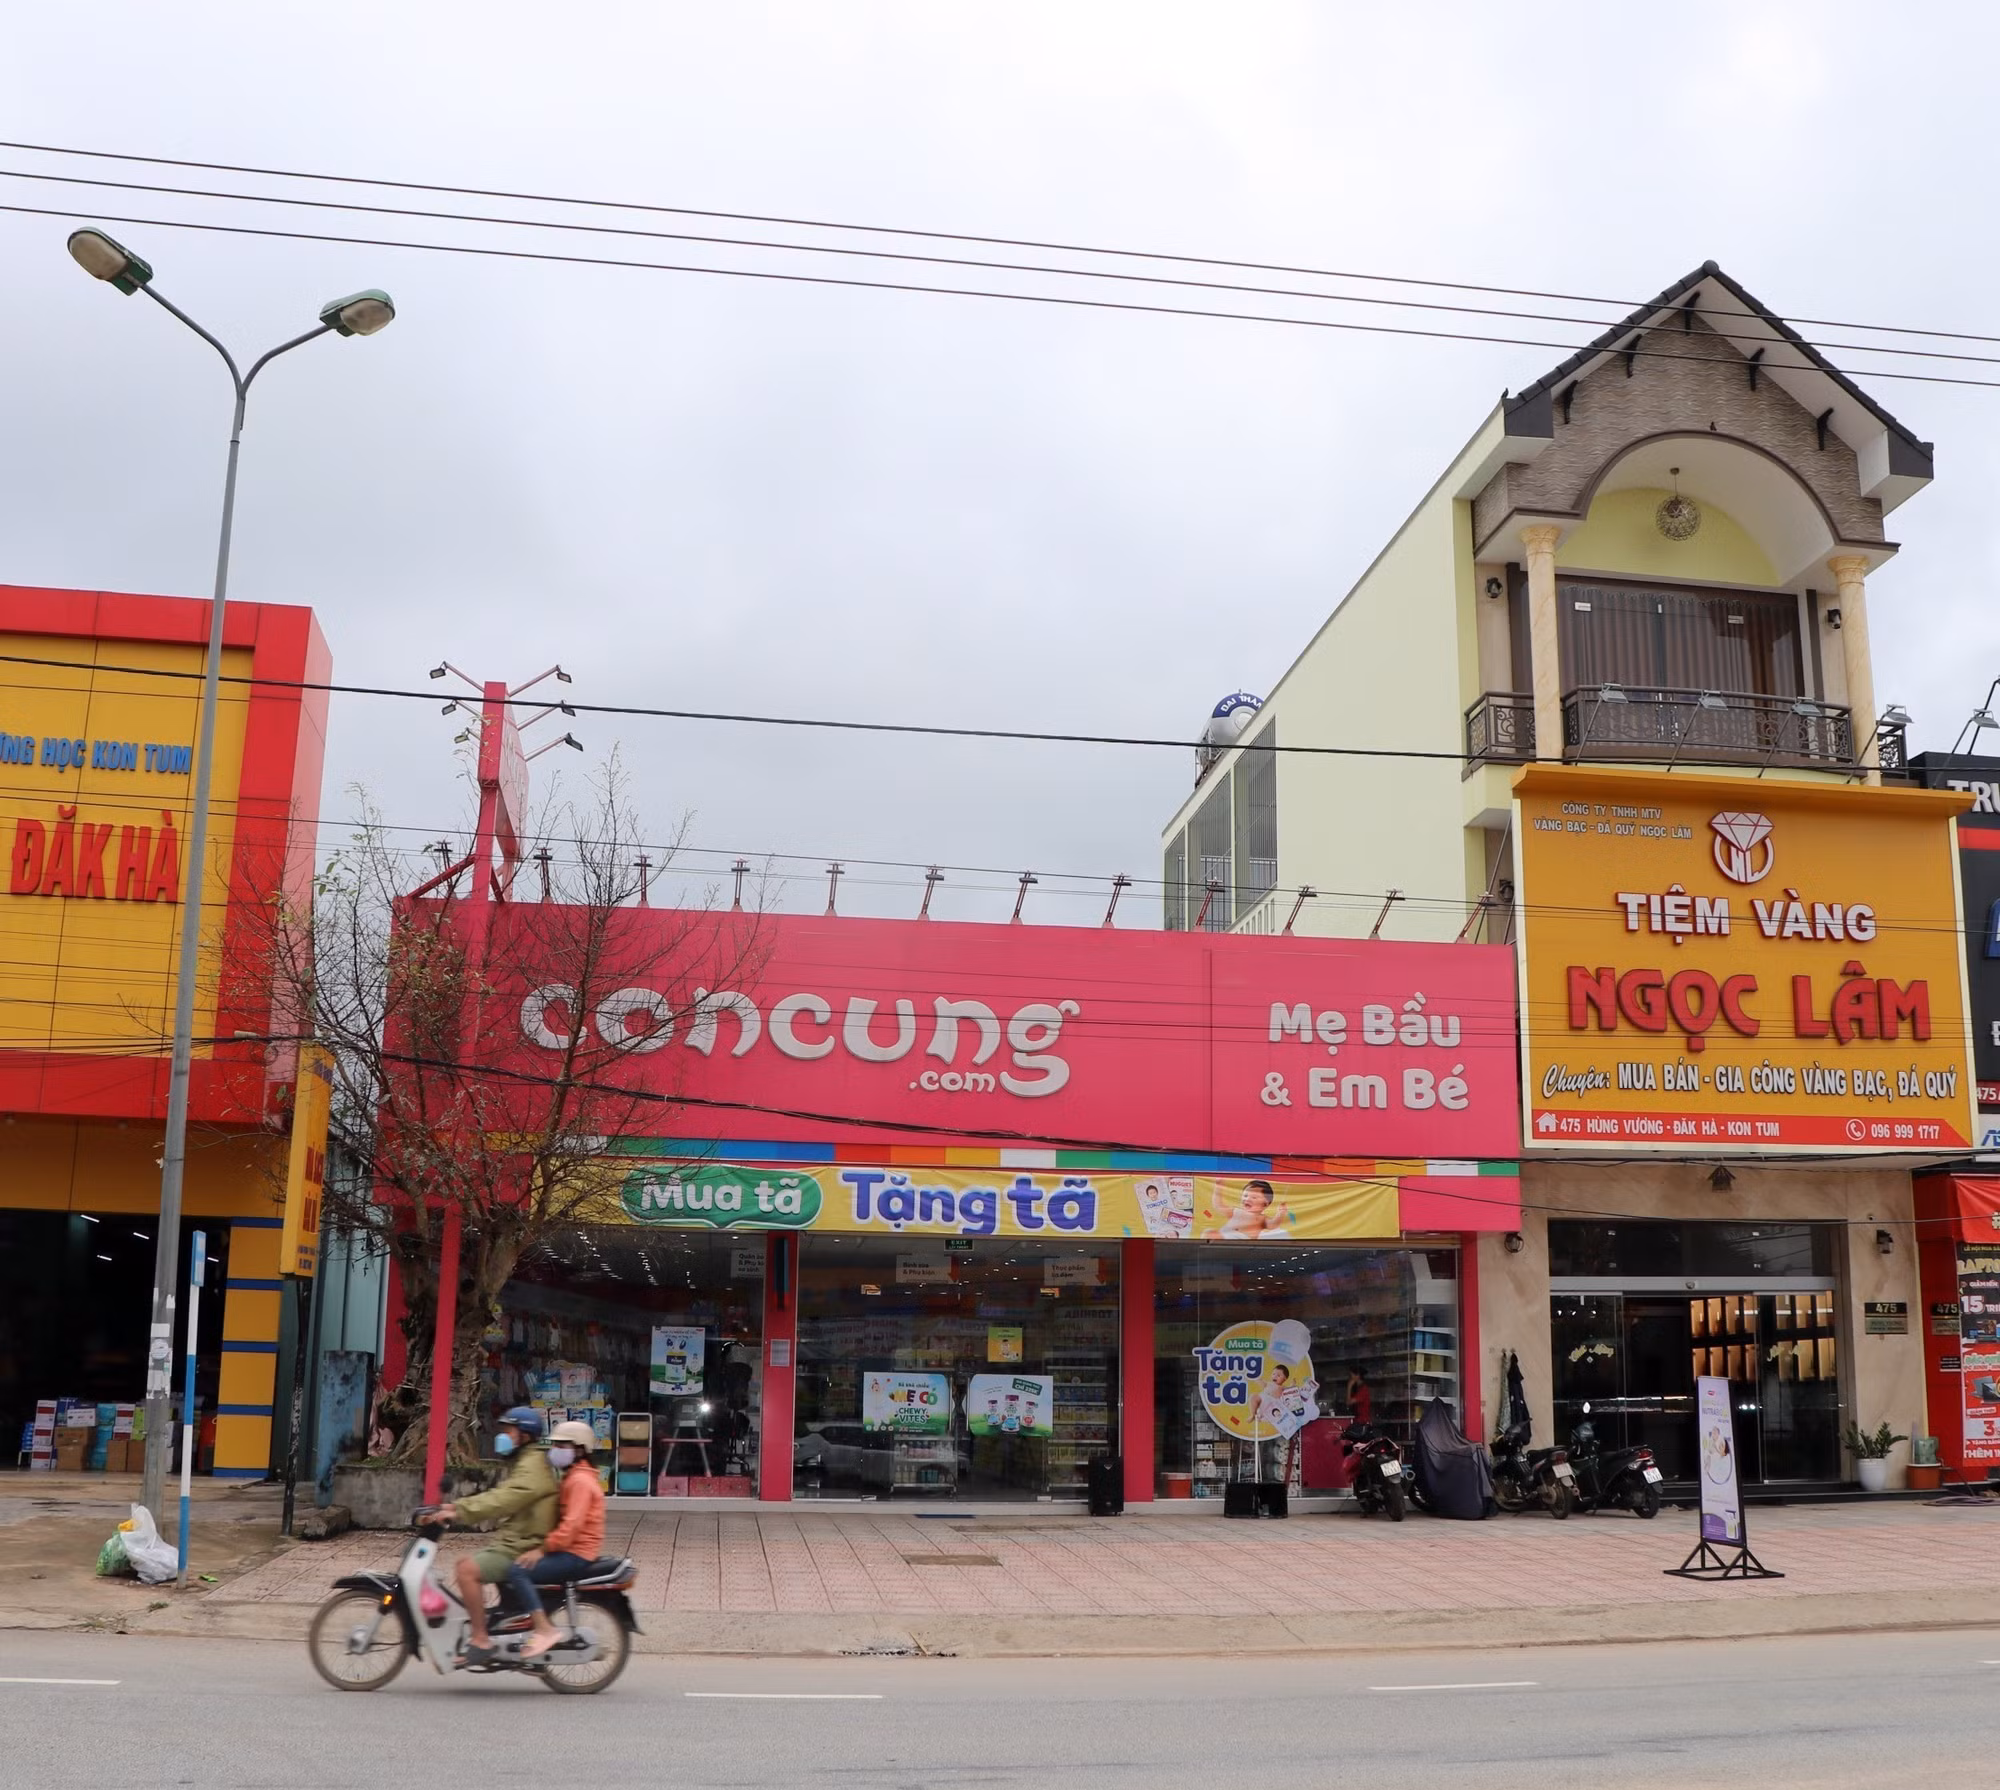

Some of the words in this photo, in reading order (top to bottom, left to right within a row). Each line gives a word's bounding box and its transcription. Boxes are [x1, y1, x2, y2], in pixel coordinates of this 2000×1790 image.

[41, 737, 86, 773] HỌC
[92, 741, 138, 771] KON
[145, 744, 192, 774] TUM
[1562, 801, 1589, 815] CÔNG
[1594, 805, 1606, 816] TY
[1611, 806, 1637, 818] TNHH
[1641, 808, 1661, 819] MTV
[1533, 816, 1562, 831] VÀNG
[1567, 820, 1587, 836] BẠC
[1597, 819, 1611, 834] ĐÁ
[1615, 821, 1635, 836] QUÝ
[1640, 825, 1667, 840] NGỌC
[10, 804, 113, 897] ĐĂK
[115, 809, 178, 903] HÀ
[1616, 883, 1730, 945] TIỆM
[1752, 888, 1877, 942] VÀNG
[1567, 965, 1760, 1052] NGỌC
[1792, 960, 1931, 1046] LÂM
[1268, 1001, 1348, 1056] Mẹ
[1362, 991, 1462, 1048] Bầu
[520, 983, 1081, 1098] concung
[909, 1070, 996, 1093] .com
[1260, 1071, 1293, 1107] &
[1308, 1067, 1388, 1109] Em
[1403, 1063, 1470, 1111] Bé
[1542, 1064, 1611, 1098] Chuyên:
[1617, 1062, 1657, 1090] MUA
[1663, 1056, 1700, 1091] BÁN
[1715, 1066, 1745, 1092] GIA
[1750, 1059, 1796, 1094] CÔNG
[1802, 1061, 1847, 1095] VÀNG
[1852, 1069, 1893, 1103] BẠC,
[1898, 1064, 1920, 1097] ĐÁ
[1925, 1065, 1957, 1099] QUÝ
[1560, 1118, 1581, 1133] 475
[1587, 1116, 1618, 1134] HÙNG
[1623, 1118, 1663, 1135] VƯƠNG
[1673, 1118, 1697, 1135] ĐĂK
[1702, 1118, 1718, 1135] HÀ
[1727, 1121, 1751, 1136] KON
[1756, 1122, 1780, 1136] TUM
[1871, 1124, 1890, 1139] 096
[1895, 1124, 1913, 1139] 999
[1918, 1125, 1940, 1140] 1717
[641, 1173, 743, 1211] Mua
[754, 1178, 802, 1215] tã
[842, 1172, 997, 1236] Tặng
[1007, 1177, 1096, 1231] tã
[1875, 1303, 1897, 1313] 475
[1937, 1303, 1958, 1313] 475
[1961, 1295, 1984, 1313] 15
[1228, 1340, 1250, 1349] Mua
[1252, 1340, 1264, 1349] tã
[1194, 1349, 1263, 1379] Tặng
[1202, 1376, 1247, 1404] tã
[900, 1415, 926, 1424] VITES
